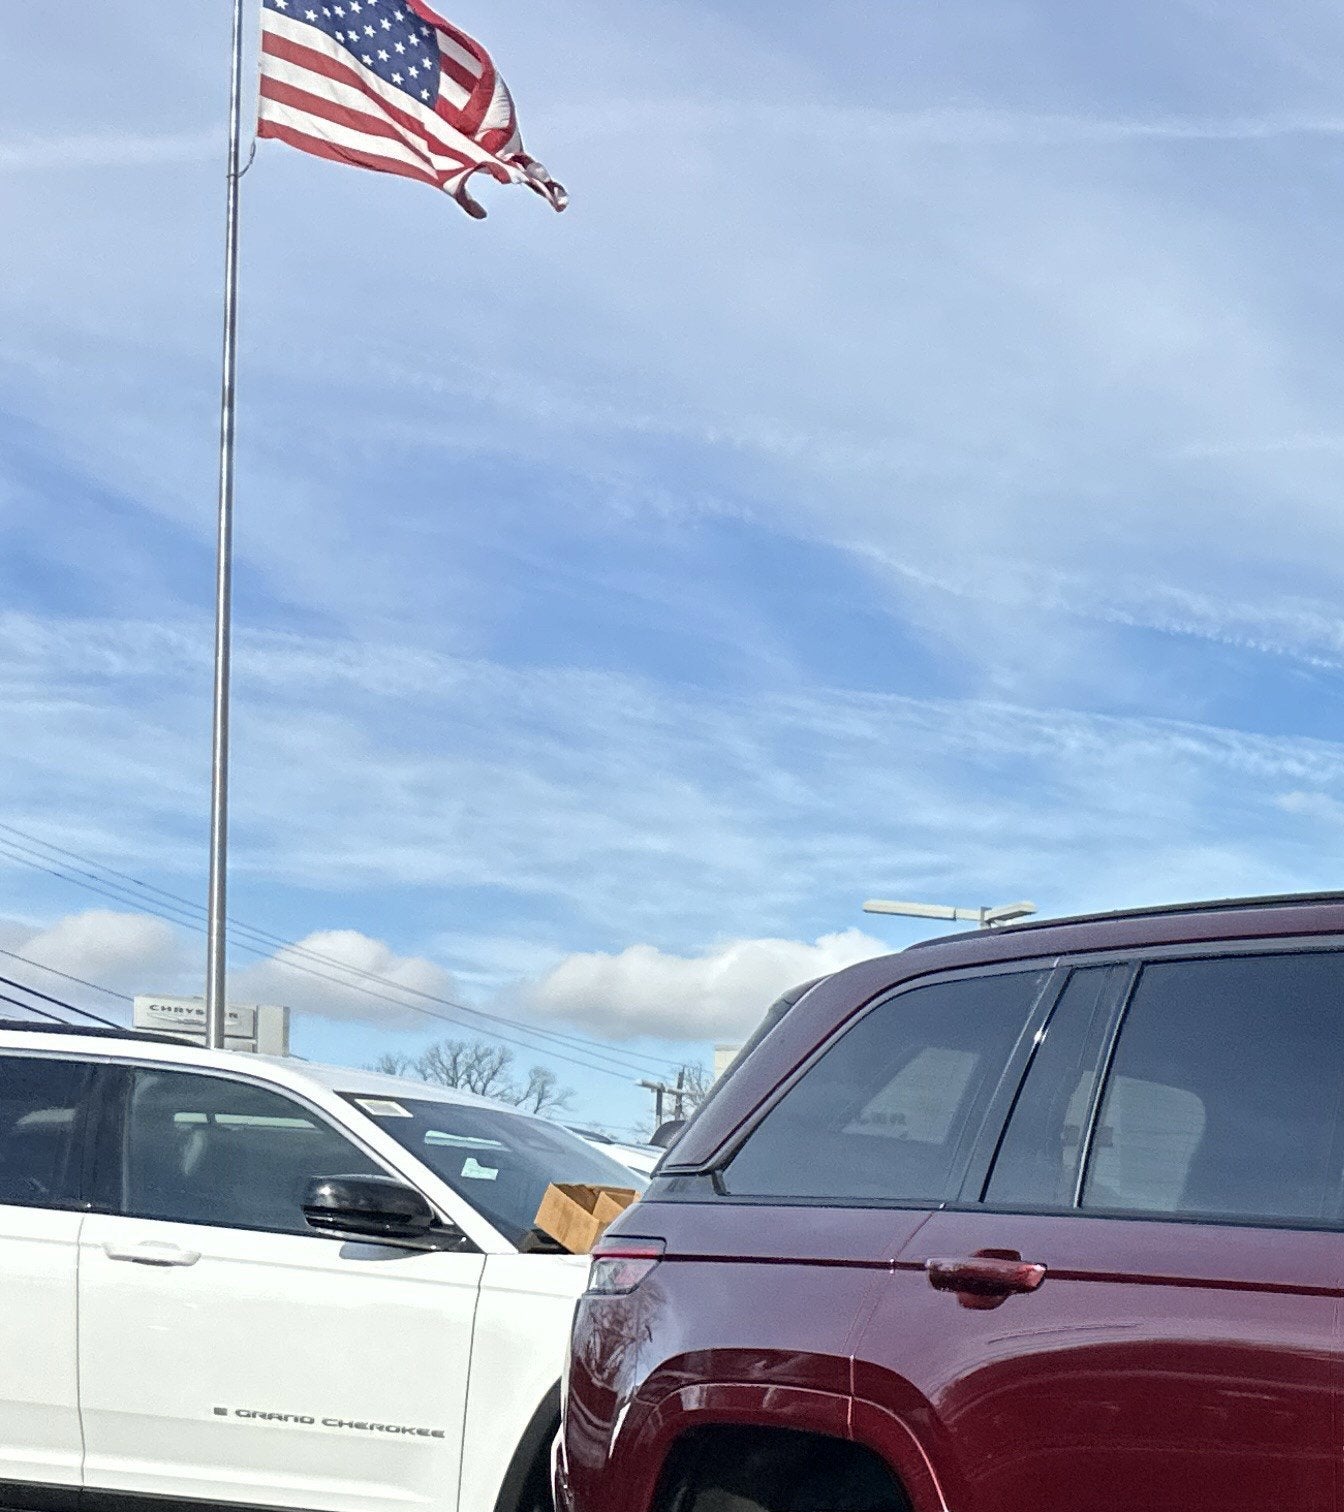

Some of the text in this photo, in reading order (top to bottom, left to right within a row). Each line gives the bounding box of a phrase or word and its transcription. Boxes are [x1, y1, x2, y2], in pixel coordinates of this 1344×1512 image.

[149, 1003, 239, 1019] CHRYSR
[235, 1408, 315, 1425] GRAND
[321, 1417, 446, 1439] CHEROKEE
